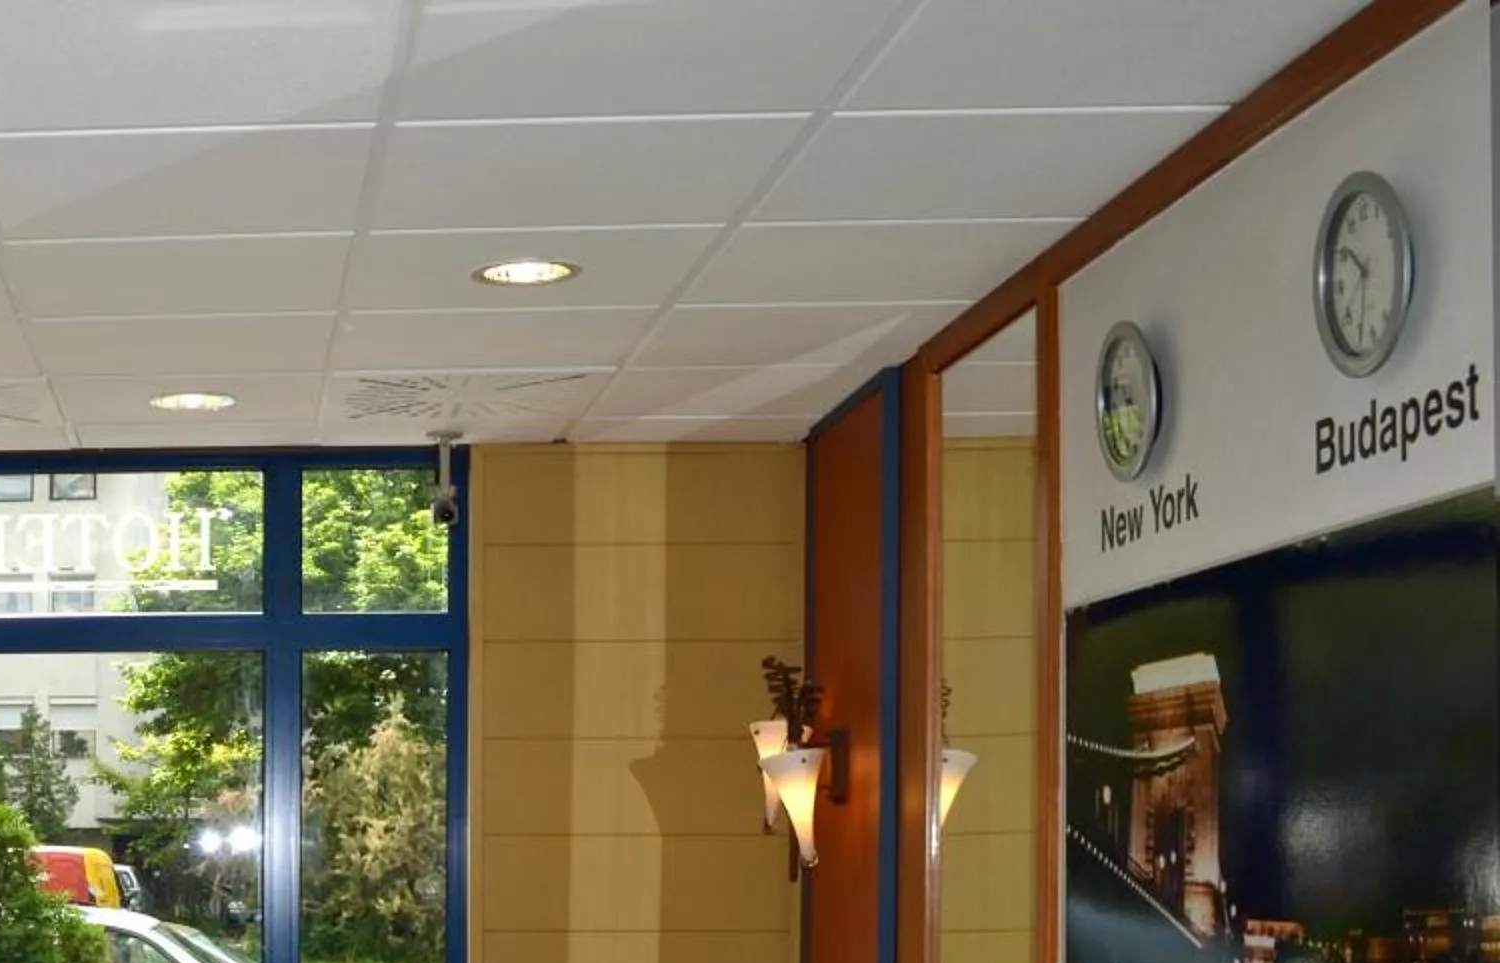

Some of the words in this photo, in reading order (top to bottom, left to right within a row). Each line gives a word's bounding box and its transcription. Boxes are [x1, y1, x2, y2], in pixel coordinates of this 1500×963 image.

[1315, 363, 1480, 475] Budapest
[1101, 504, 1144, 553] New
[1149, 472, 1199, 534] York
